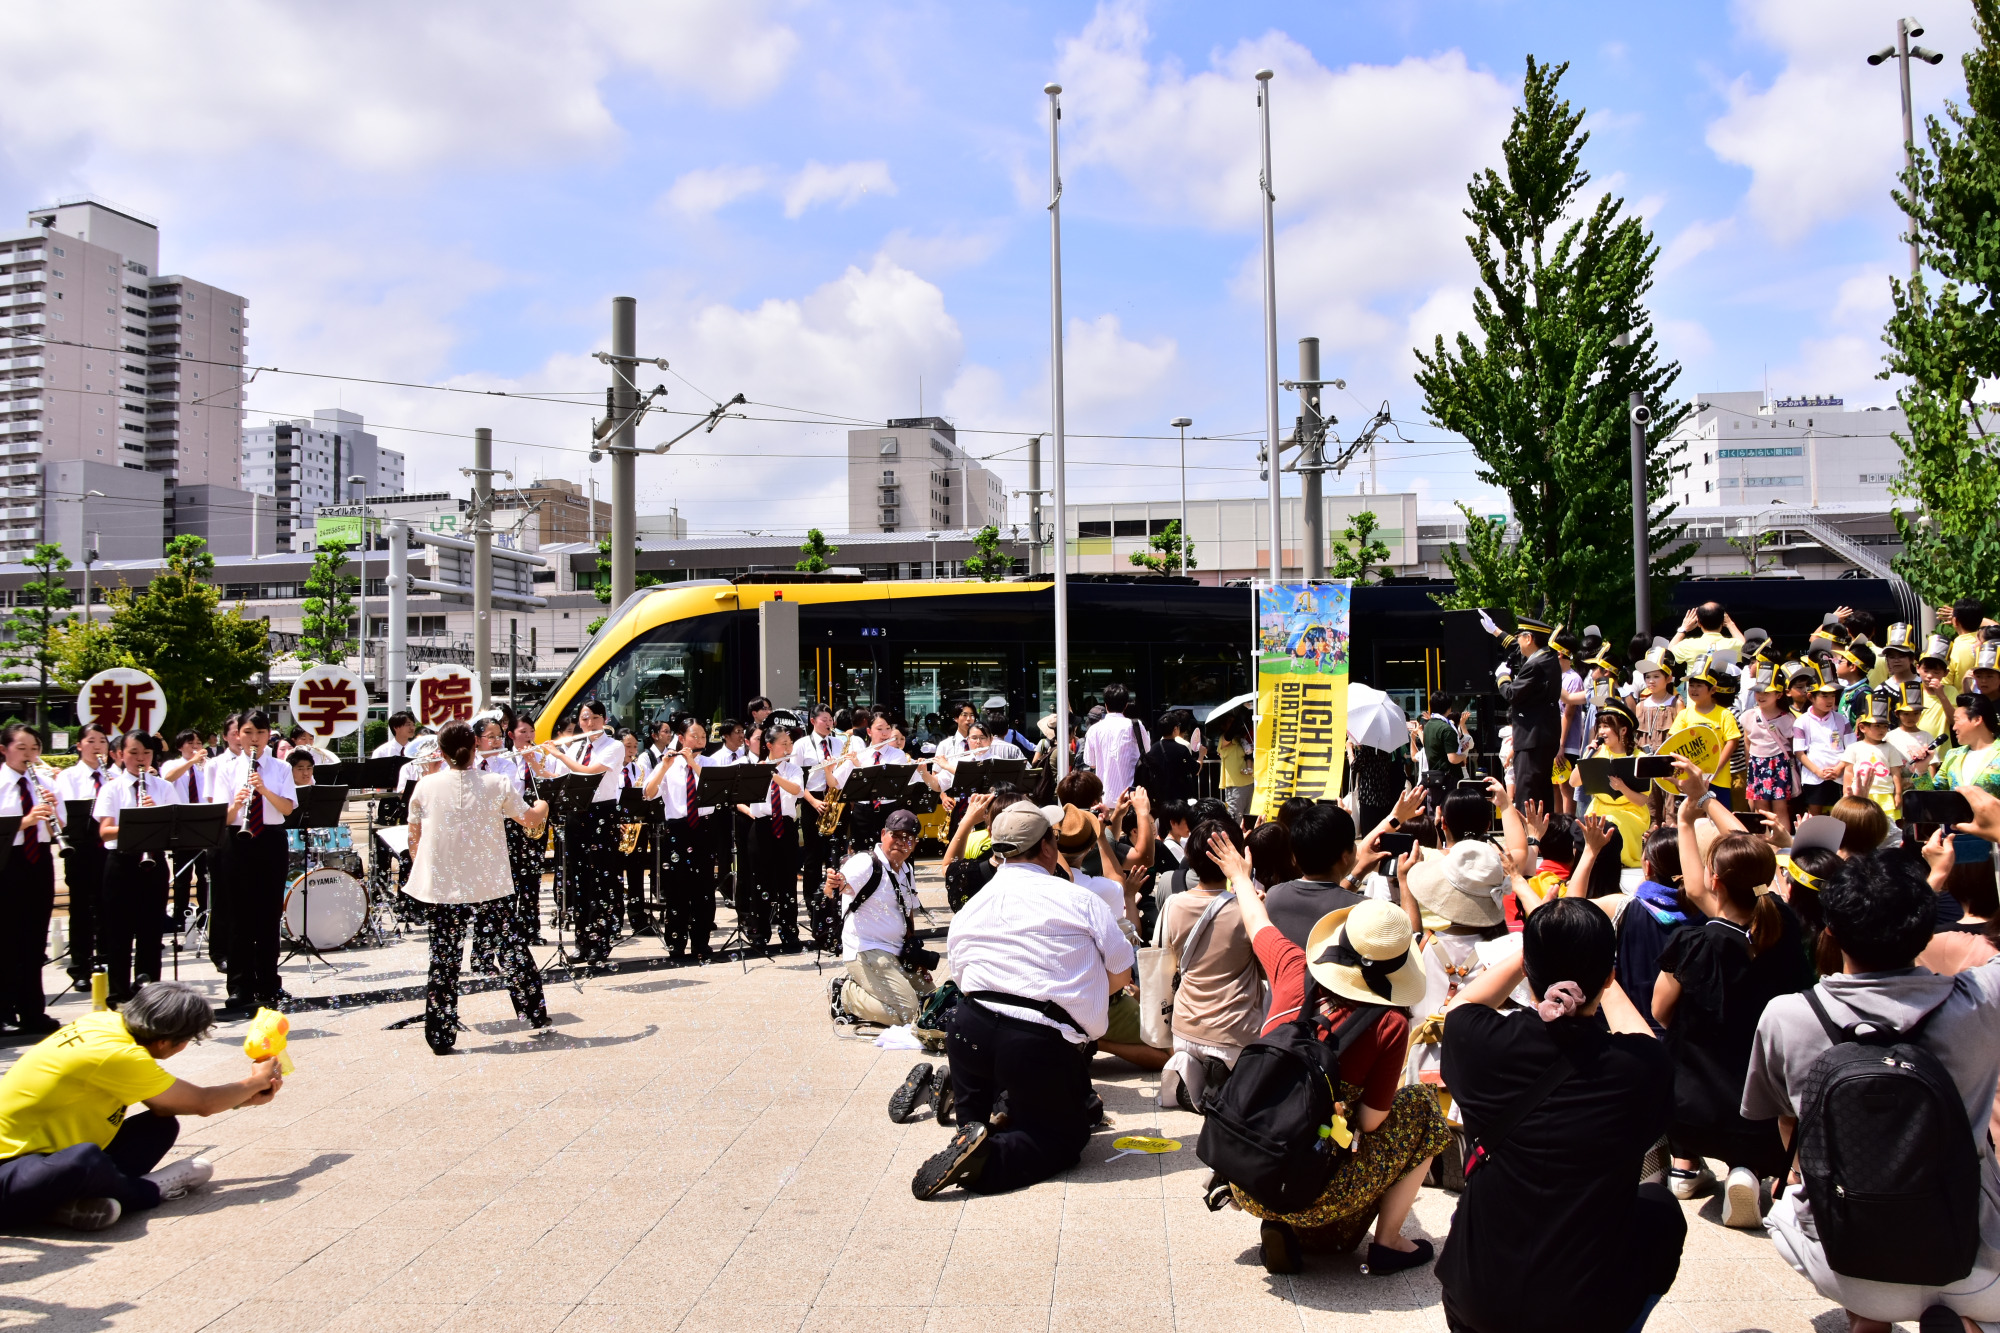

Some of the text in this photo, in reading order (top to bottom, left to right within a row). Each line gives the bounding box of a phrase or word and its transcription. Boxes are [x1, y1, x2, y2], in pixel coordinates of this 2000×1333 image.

[321, 506, 372, 516] スマイルホテル
[429, 515, 456, 532] JR
[881, 628, 887, 636] 3
[89, 679, 157, 736] 新
[298, 677, 358, 736] 学
[420, 673, 473, 726] 院
[1277, 682, 1301, 766] BIRTHDAY
